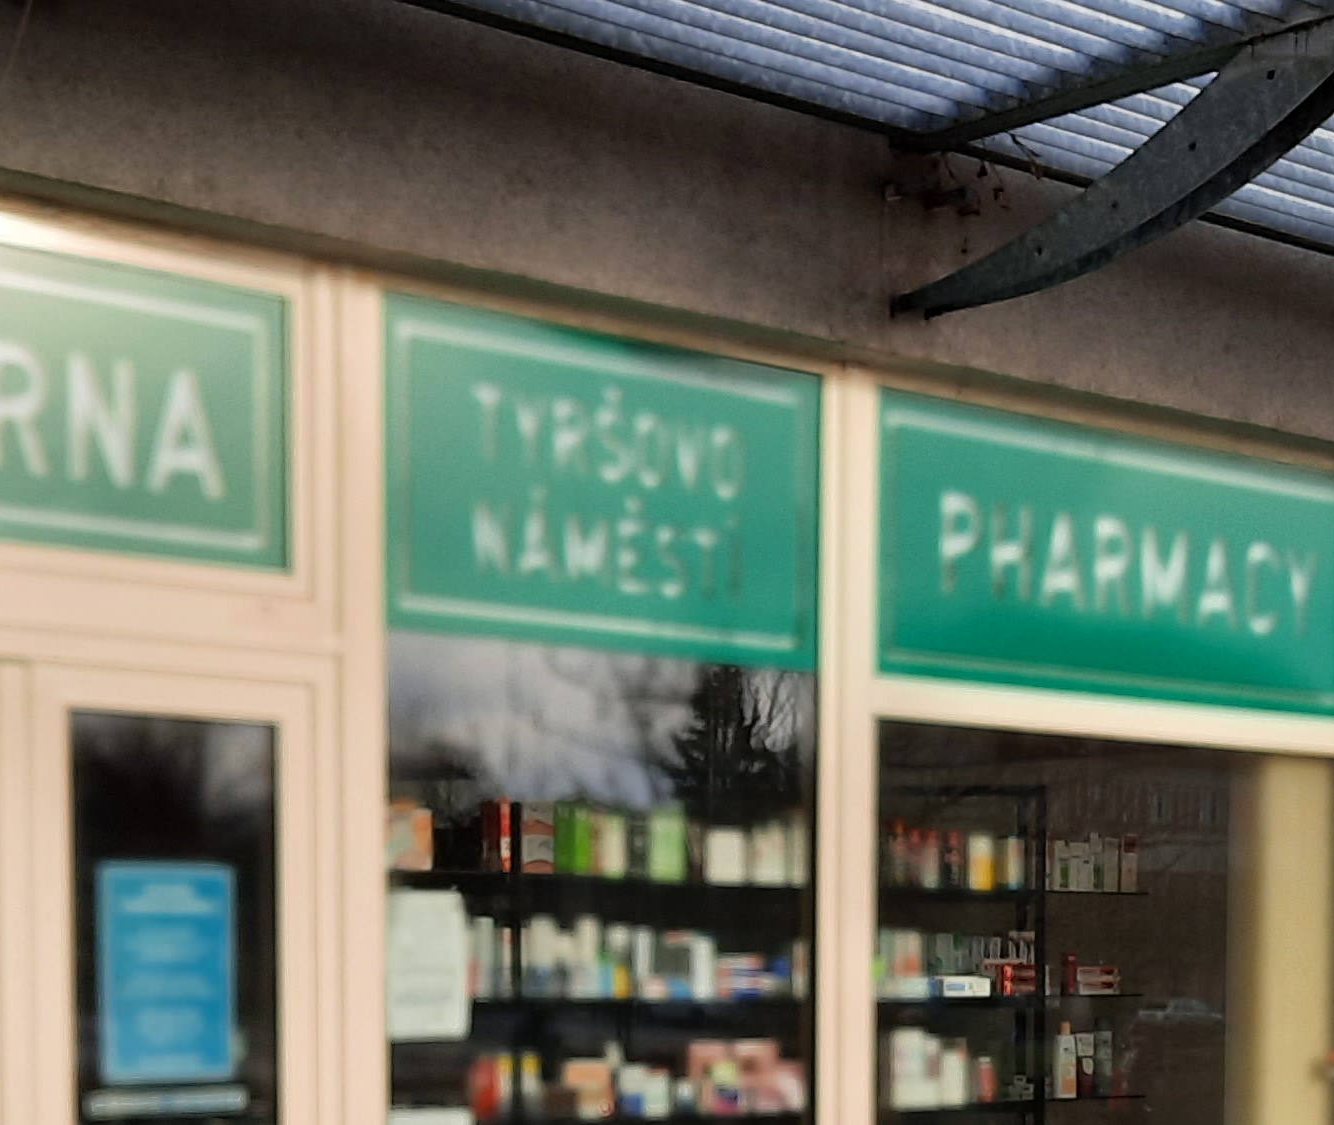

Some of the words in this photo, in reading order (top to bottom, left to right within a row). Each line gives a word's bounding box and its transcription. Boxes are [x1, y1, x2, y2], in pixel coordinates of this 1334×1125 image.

[471, 382, 746, 500] TYRŠOVO
[471, 484, 744, 602] NÁMĚSTÍ
[939, 489, 1318, 636] PHARMACY
